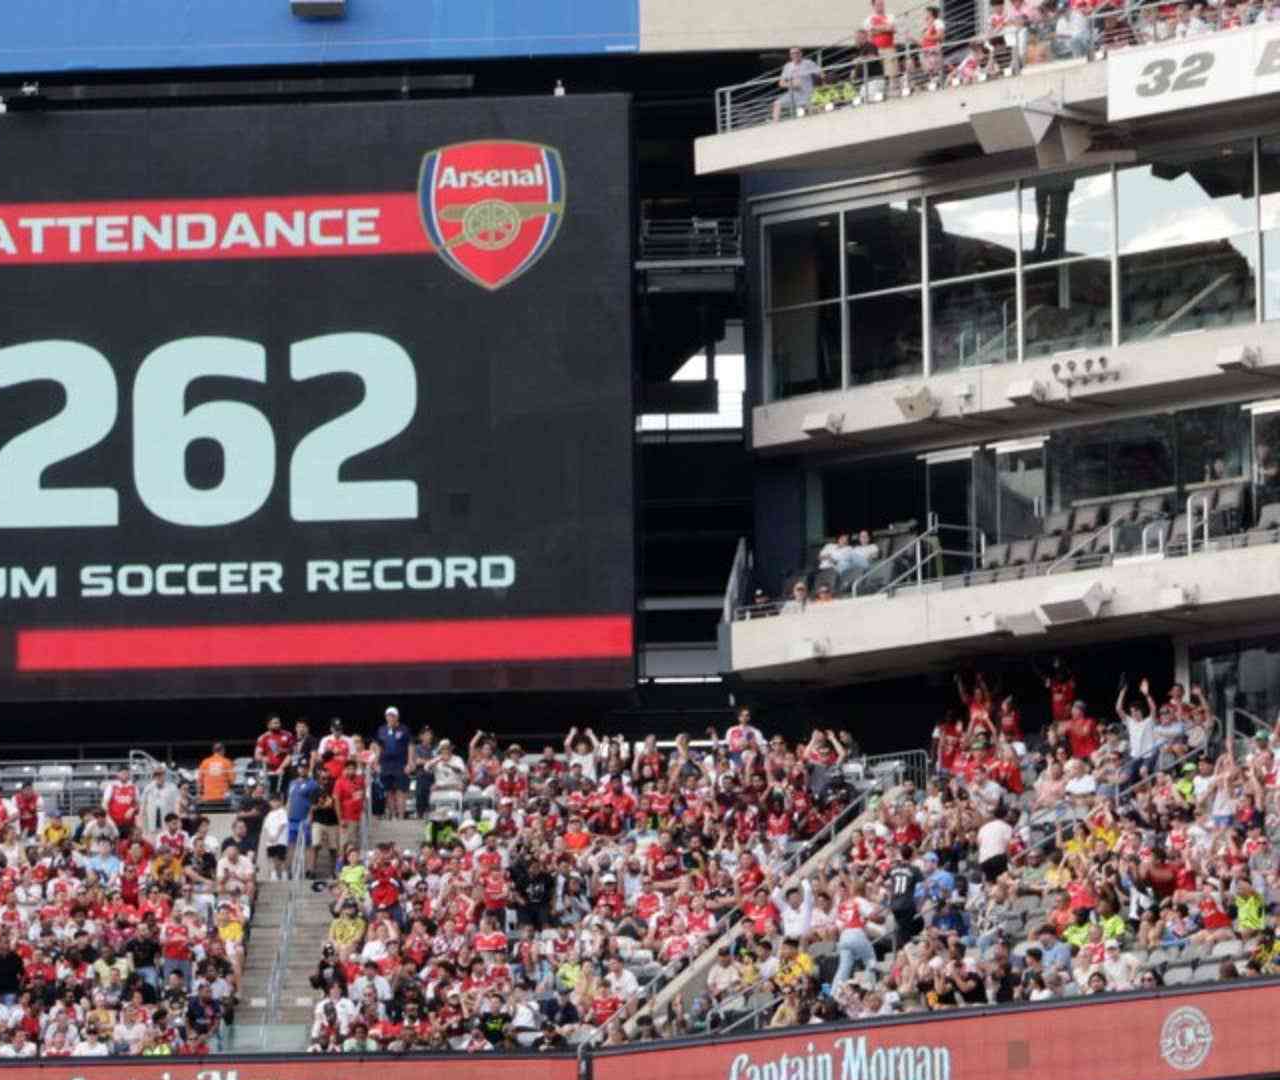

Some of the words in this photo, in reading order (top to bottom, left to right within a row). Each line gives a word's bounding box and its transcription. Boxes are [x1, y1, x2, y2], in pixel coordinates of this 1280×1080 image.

[1135, 50, 1216, 97] 32
[438, 163, 544, 189] Arsenal
[80, 561, 283, 597] SOCCER
[307, 555, 516, 592] RECORD
